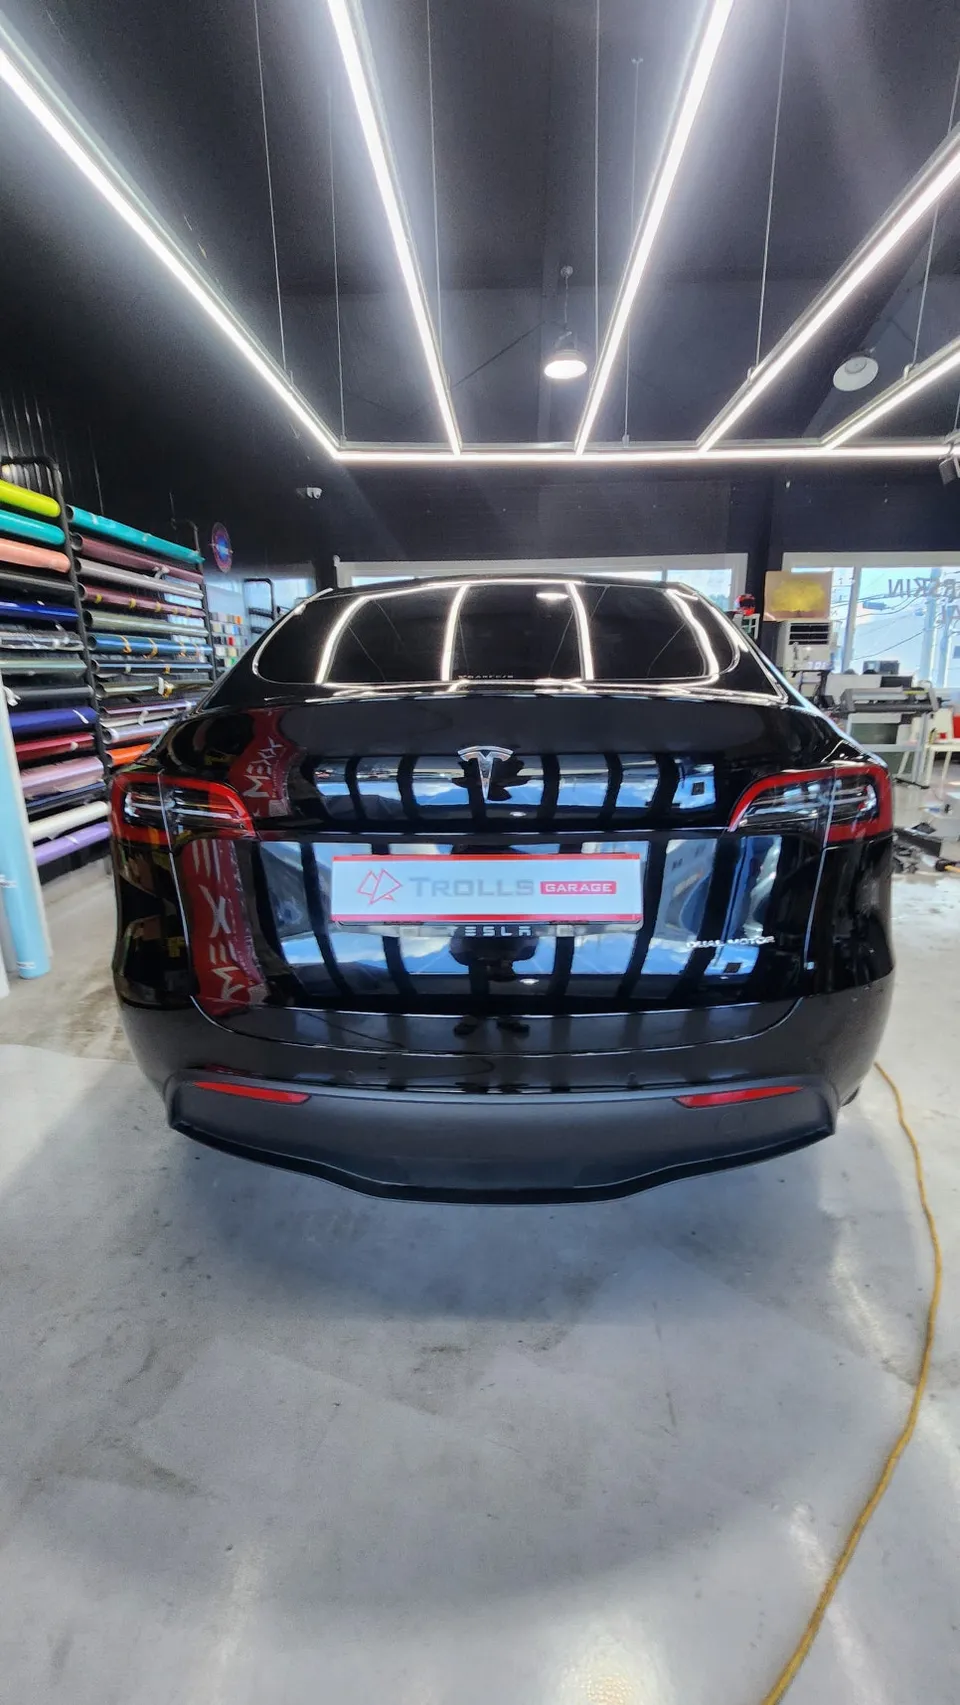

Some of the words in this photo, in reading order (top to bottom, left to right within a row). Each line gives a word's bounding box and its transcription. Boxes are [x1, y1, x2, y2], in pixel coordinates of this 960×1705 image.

[408, 877, 535, 897] TROLLS
[545, 883, 614, 894] GARAGE
[727, 935, 775, 945] MOTOR
